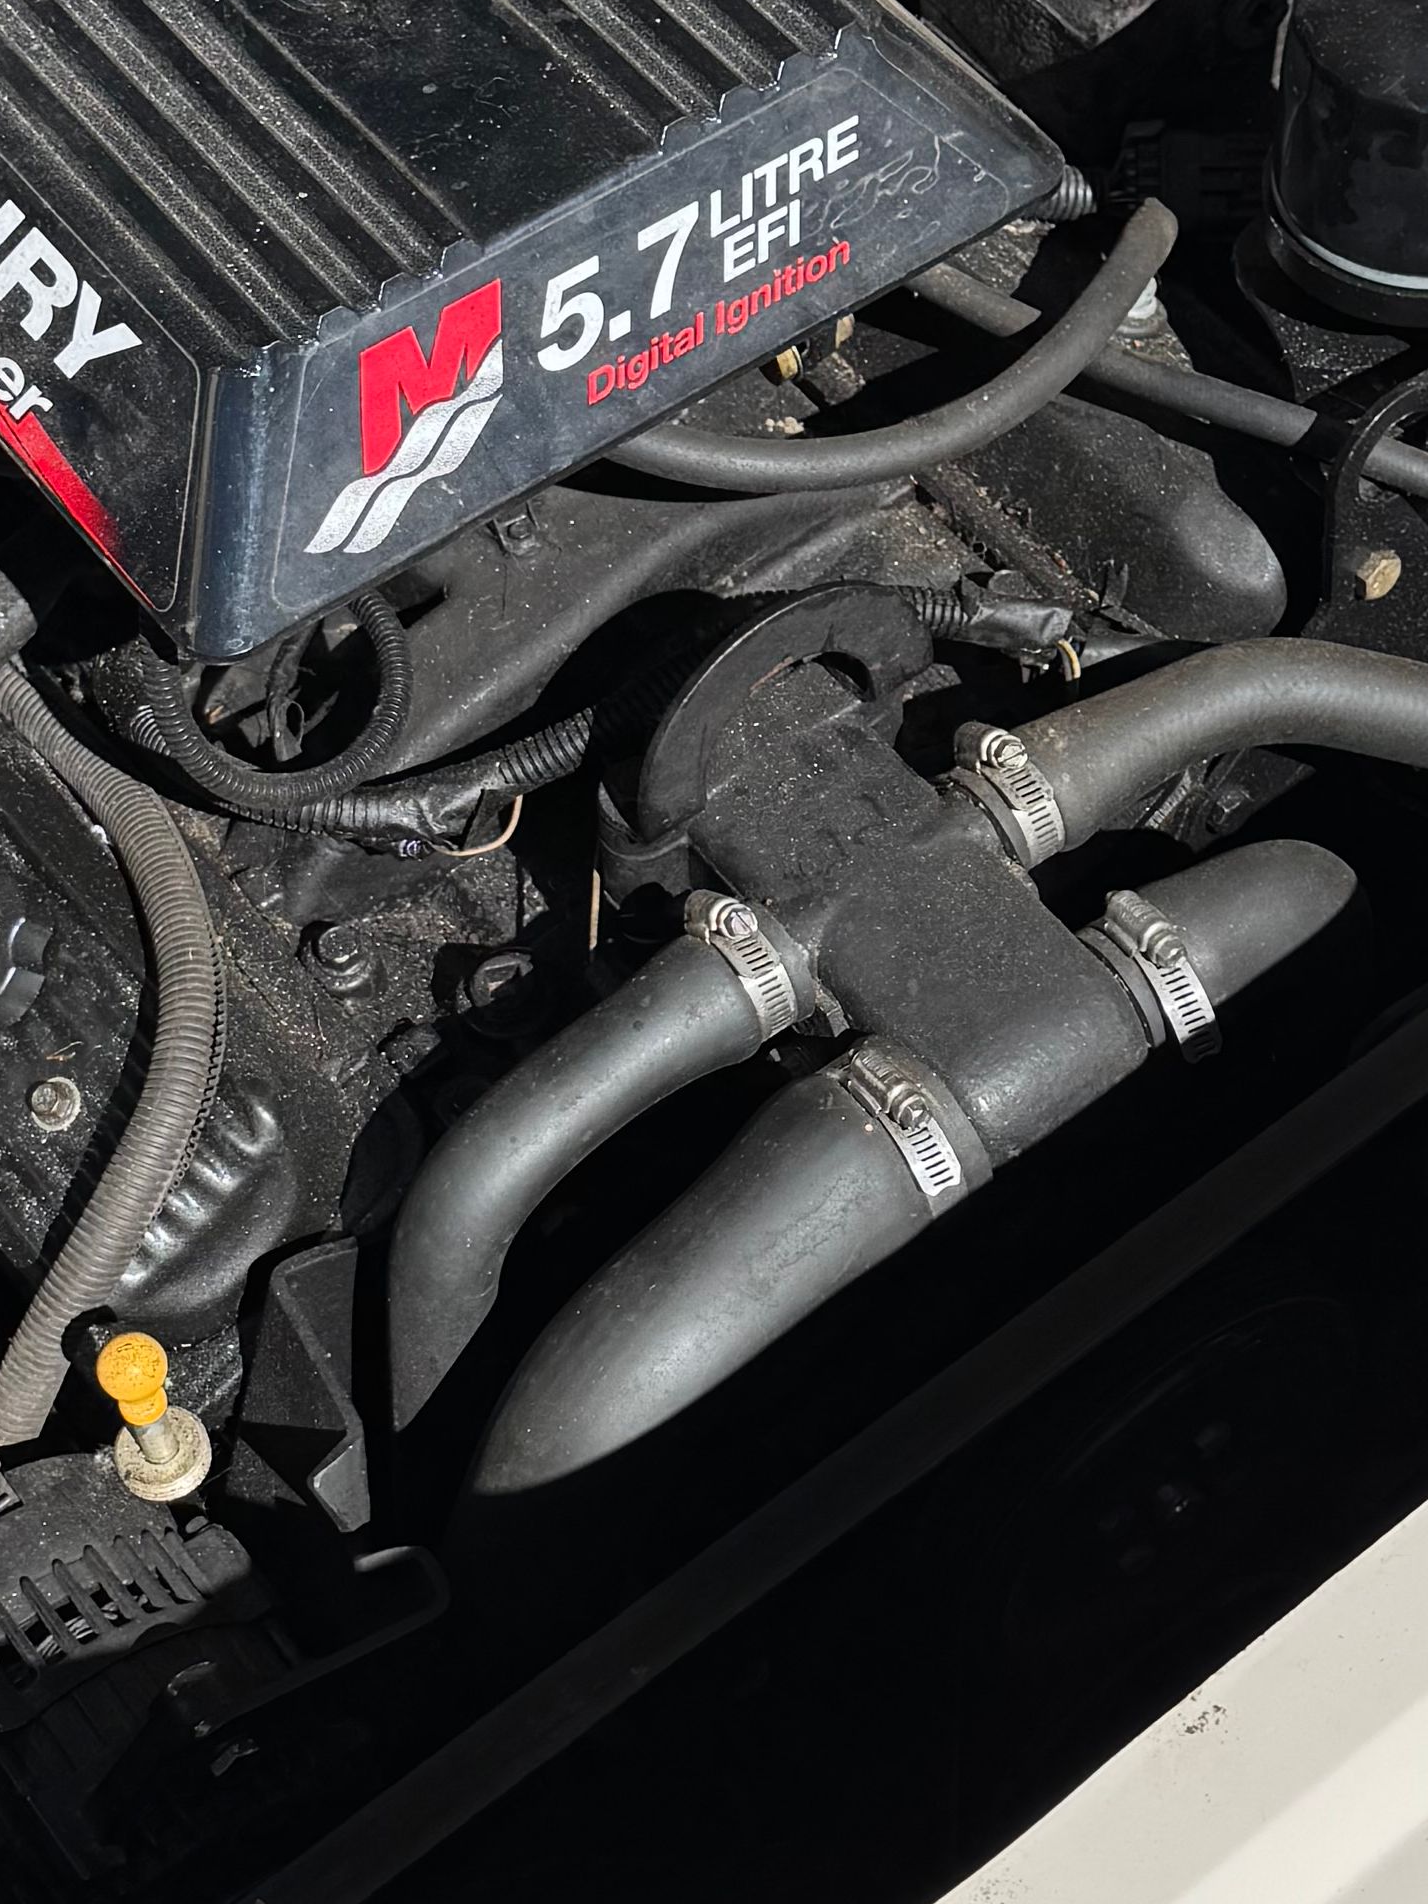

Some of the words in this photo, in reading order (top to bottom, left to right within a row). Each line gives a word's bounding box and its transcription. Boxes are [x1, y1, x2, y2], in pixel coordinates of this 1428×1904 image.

[537, 200, 700, 372] 5.7
[709, 115, 860, 238] LITRE
[587, 311, 705, 406] Digital
[715, 237, 851, 335] Ignition
[723, 198, 801, 283] EFI
